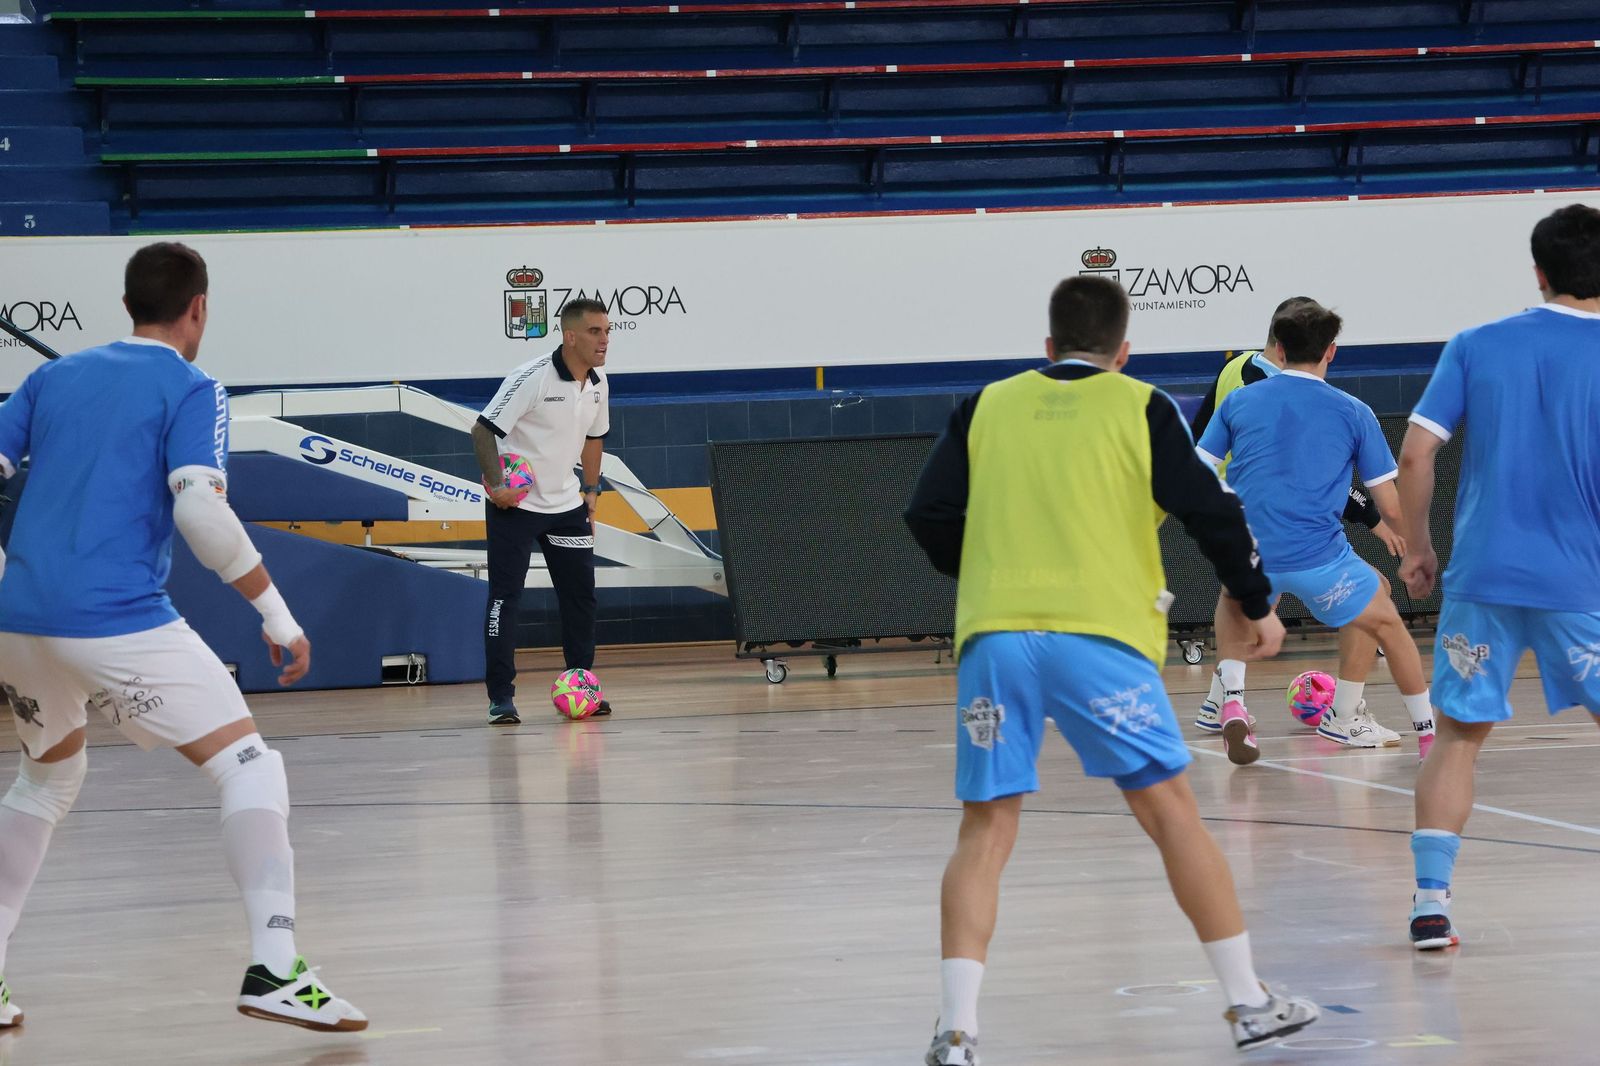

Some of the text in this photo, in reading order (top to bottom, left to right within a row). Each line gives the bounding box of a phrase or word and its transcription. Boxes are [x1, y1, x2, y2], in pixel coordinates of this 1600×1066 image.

[1125, 264, 1254, 297] ZAMORA
[338, 448, 482, 503] Schelde Sports
